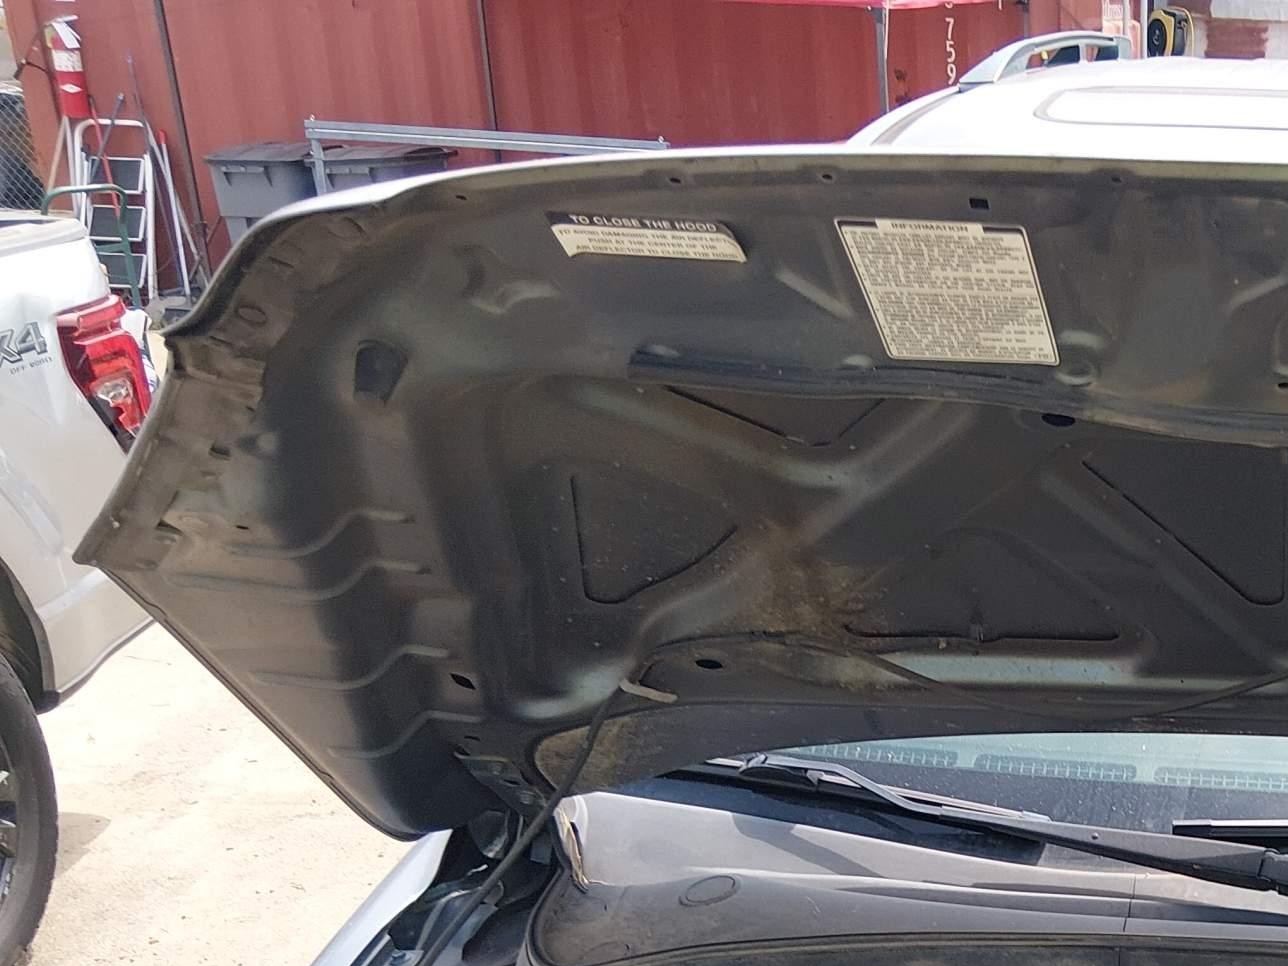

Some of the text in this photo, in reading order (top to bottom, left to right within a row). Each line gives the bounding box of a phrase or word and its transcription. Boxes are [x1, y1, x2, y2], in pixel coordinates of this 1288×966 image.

[568, 214, 718, 233] TO CLOSE THE HOOD
[890, 222, 969, 233] INFORMATION
